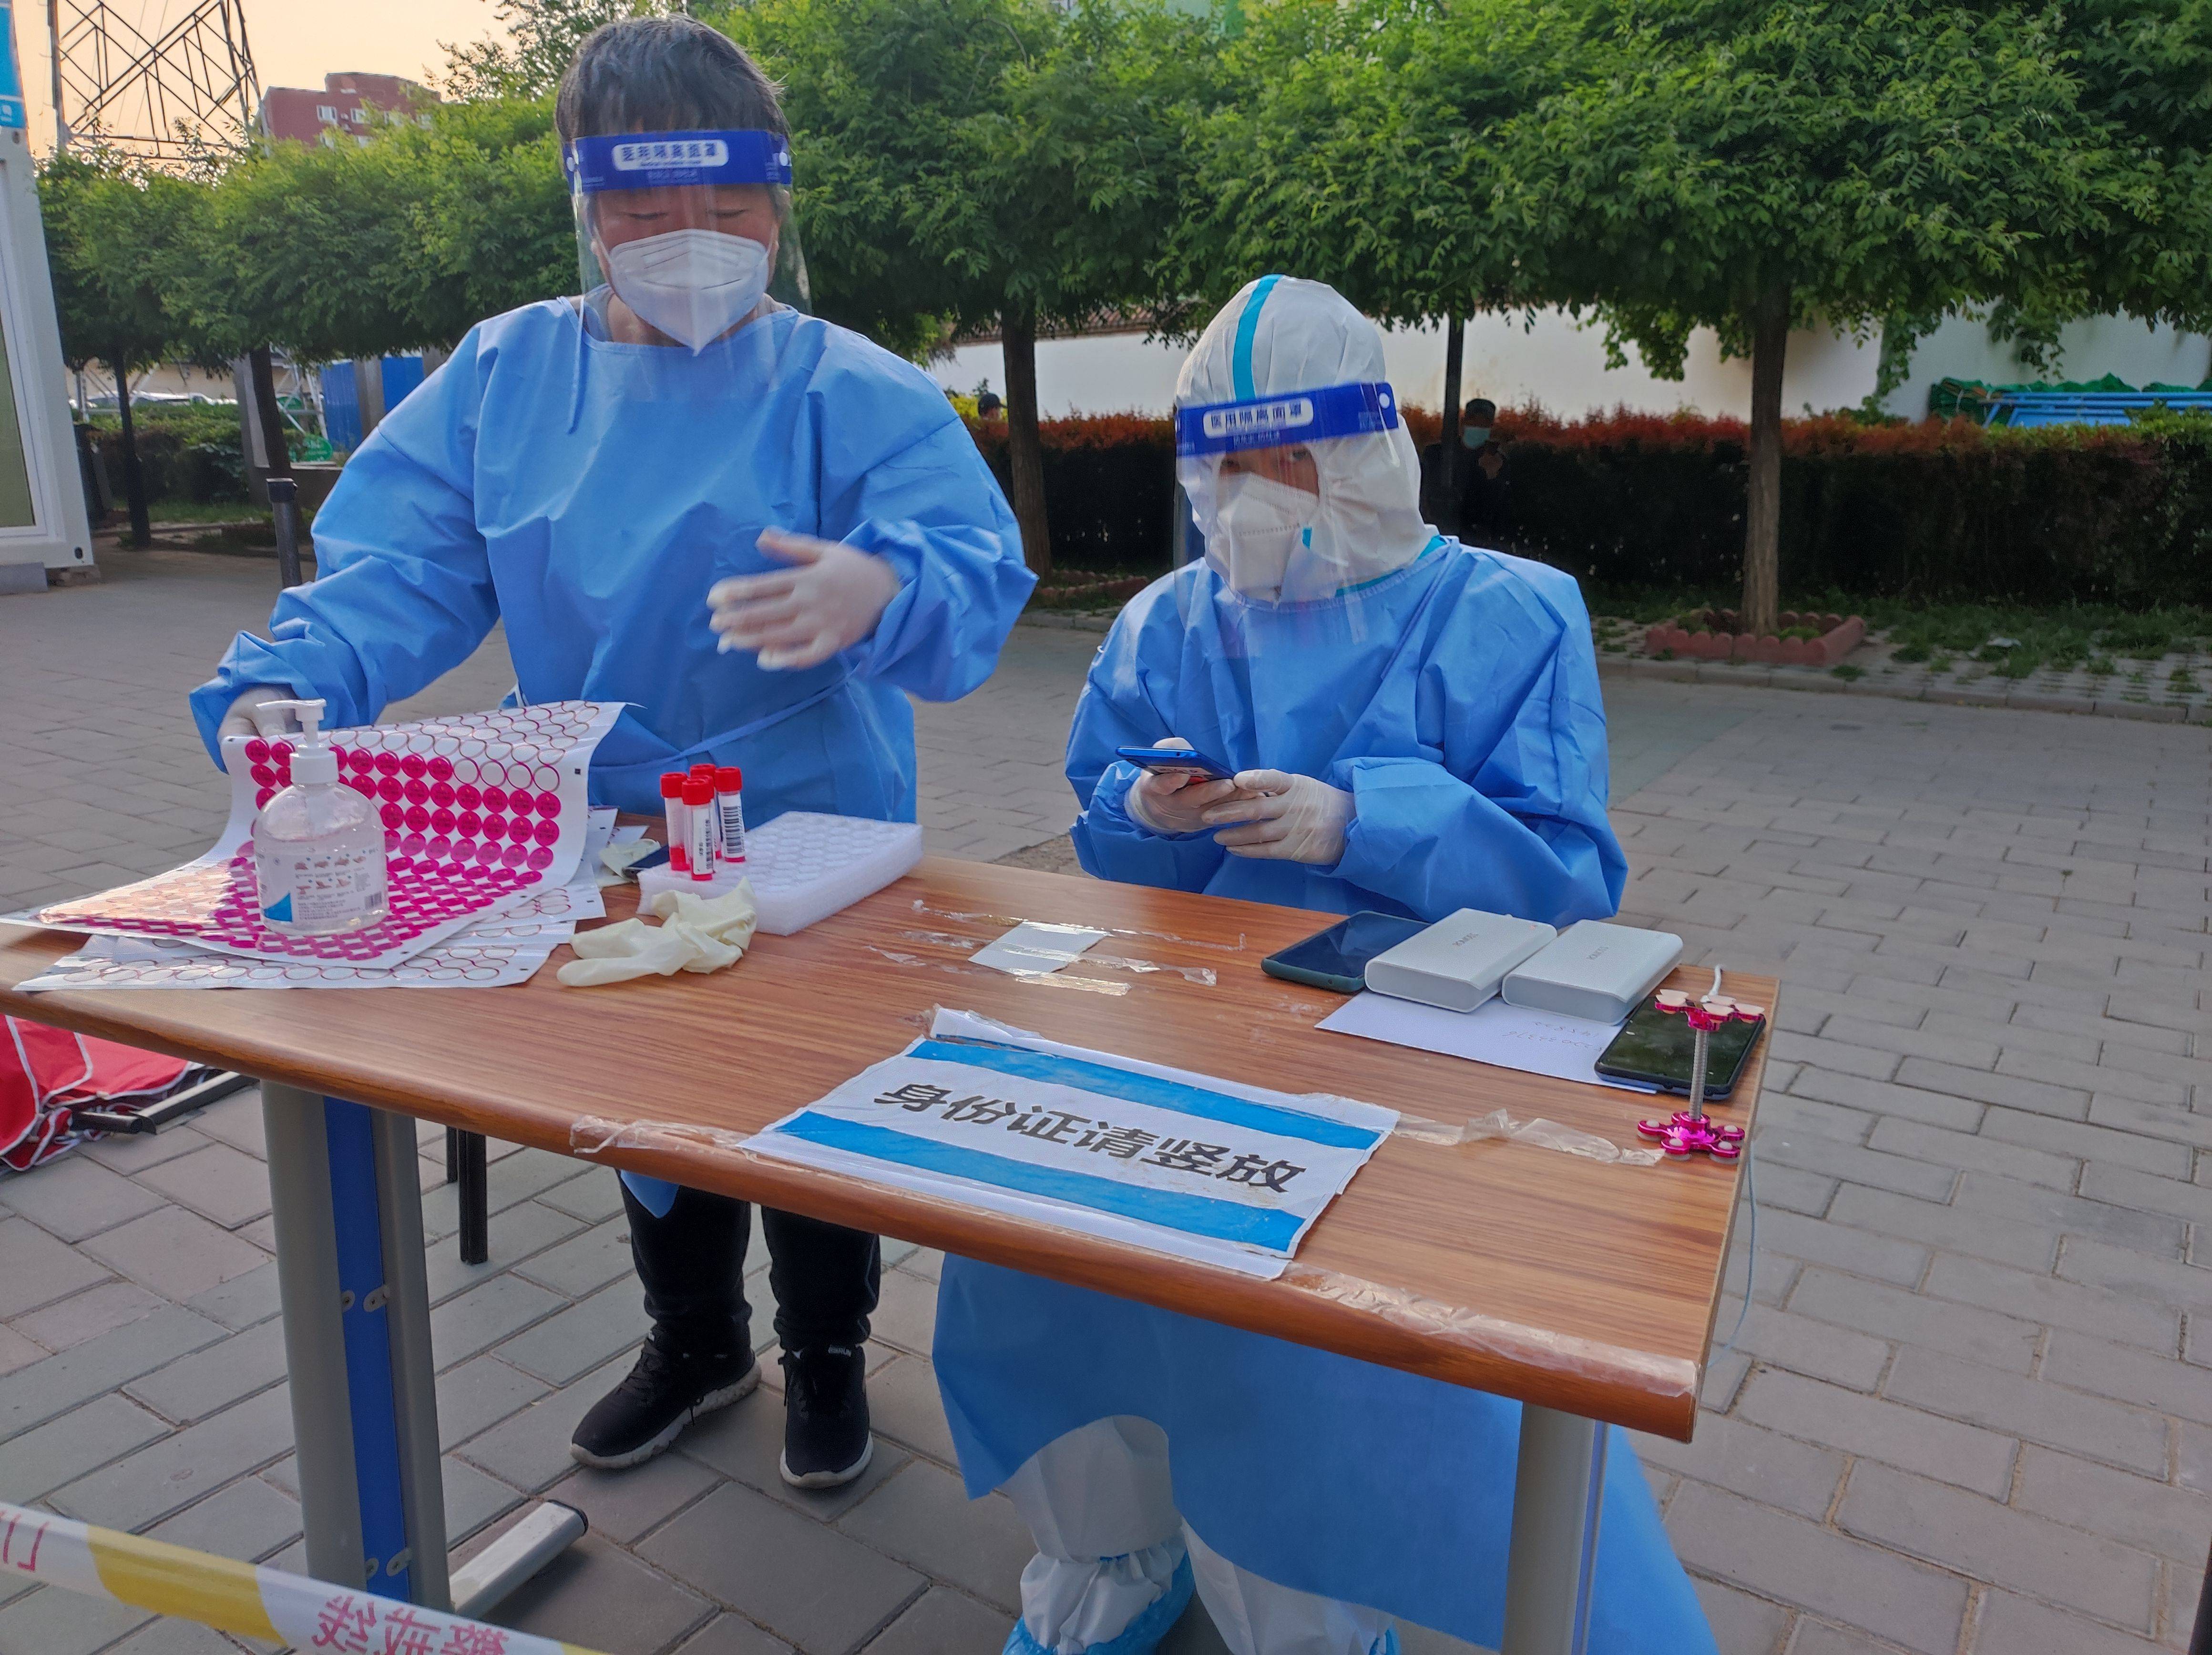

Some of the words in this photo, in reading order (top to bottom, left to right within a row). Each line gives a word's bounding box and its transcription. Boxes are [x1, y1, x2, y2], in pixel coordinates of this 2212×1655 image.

[1210, 400, 1302, 430] 医用隔离面罩
[874, 1083, 1307, 1193] 身份证请竖放
